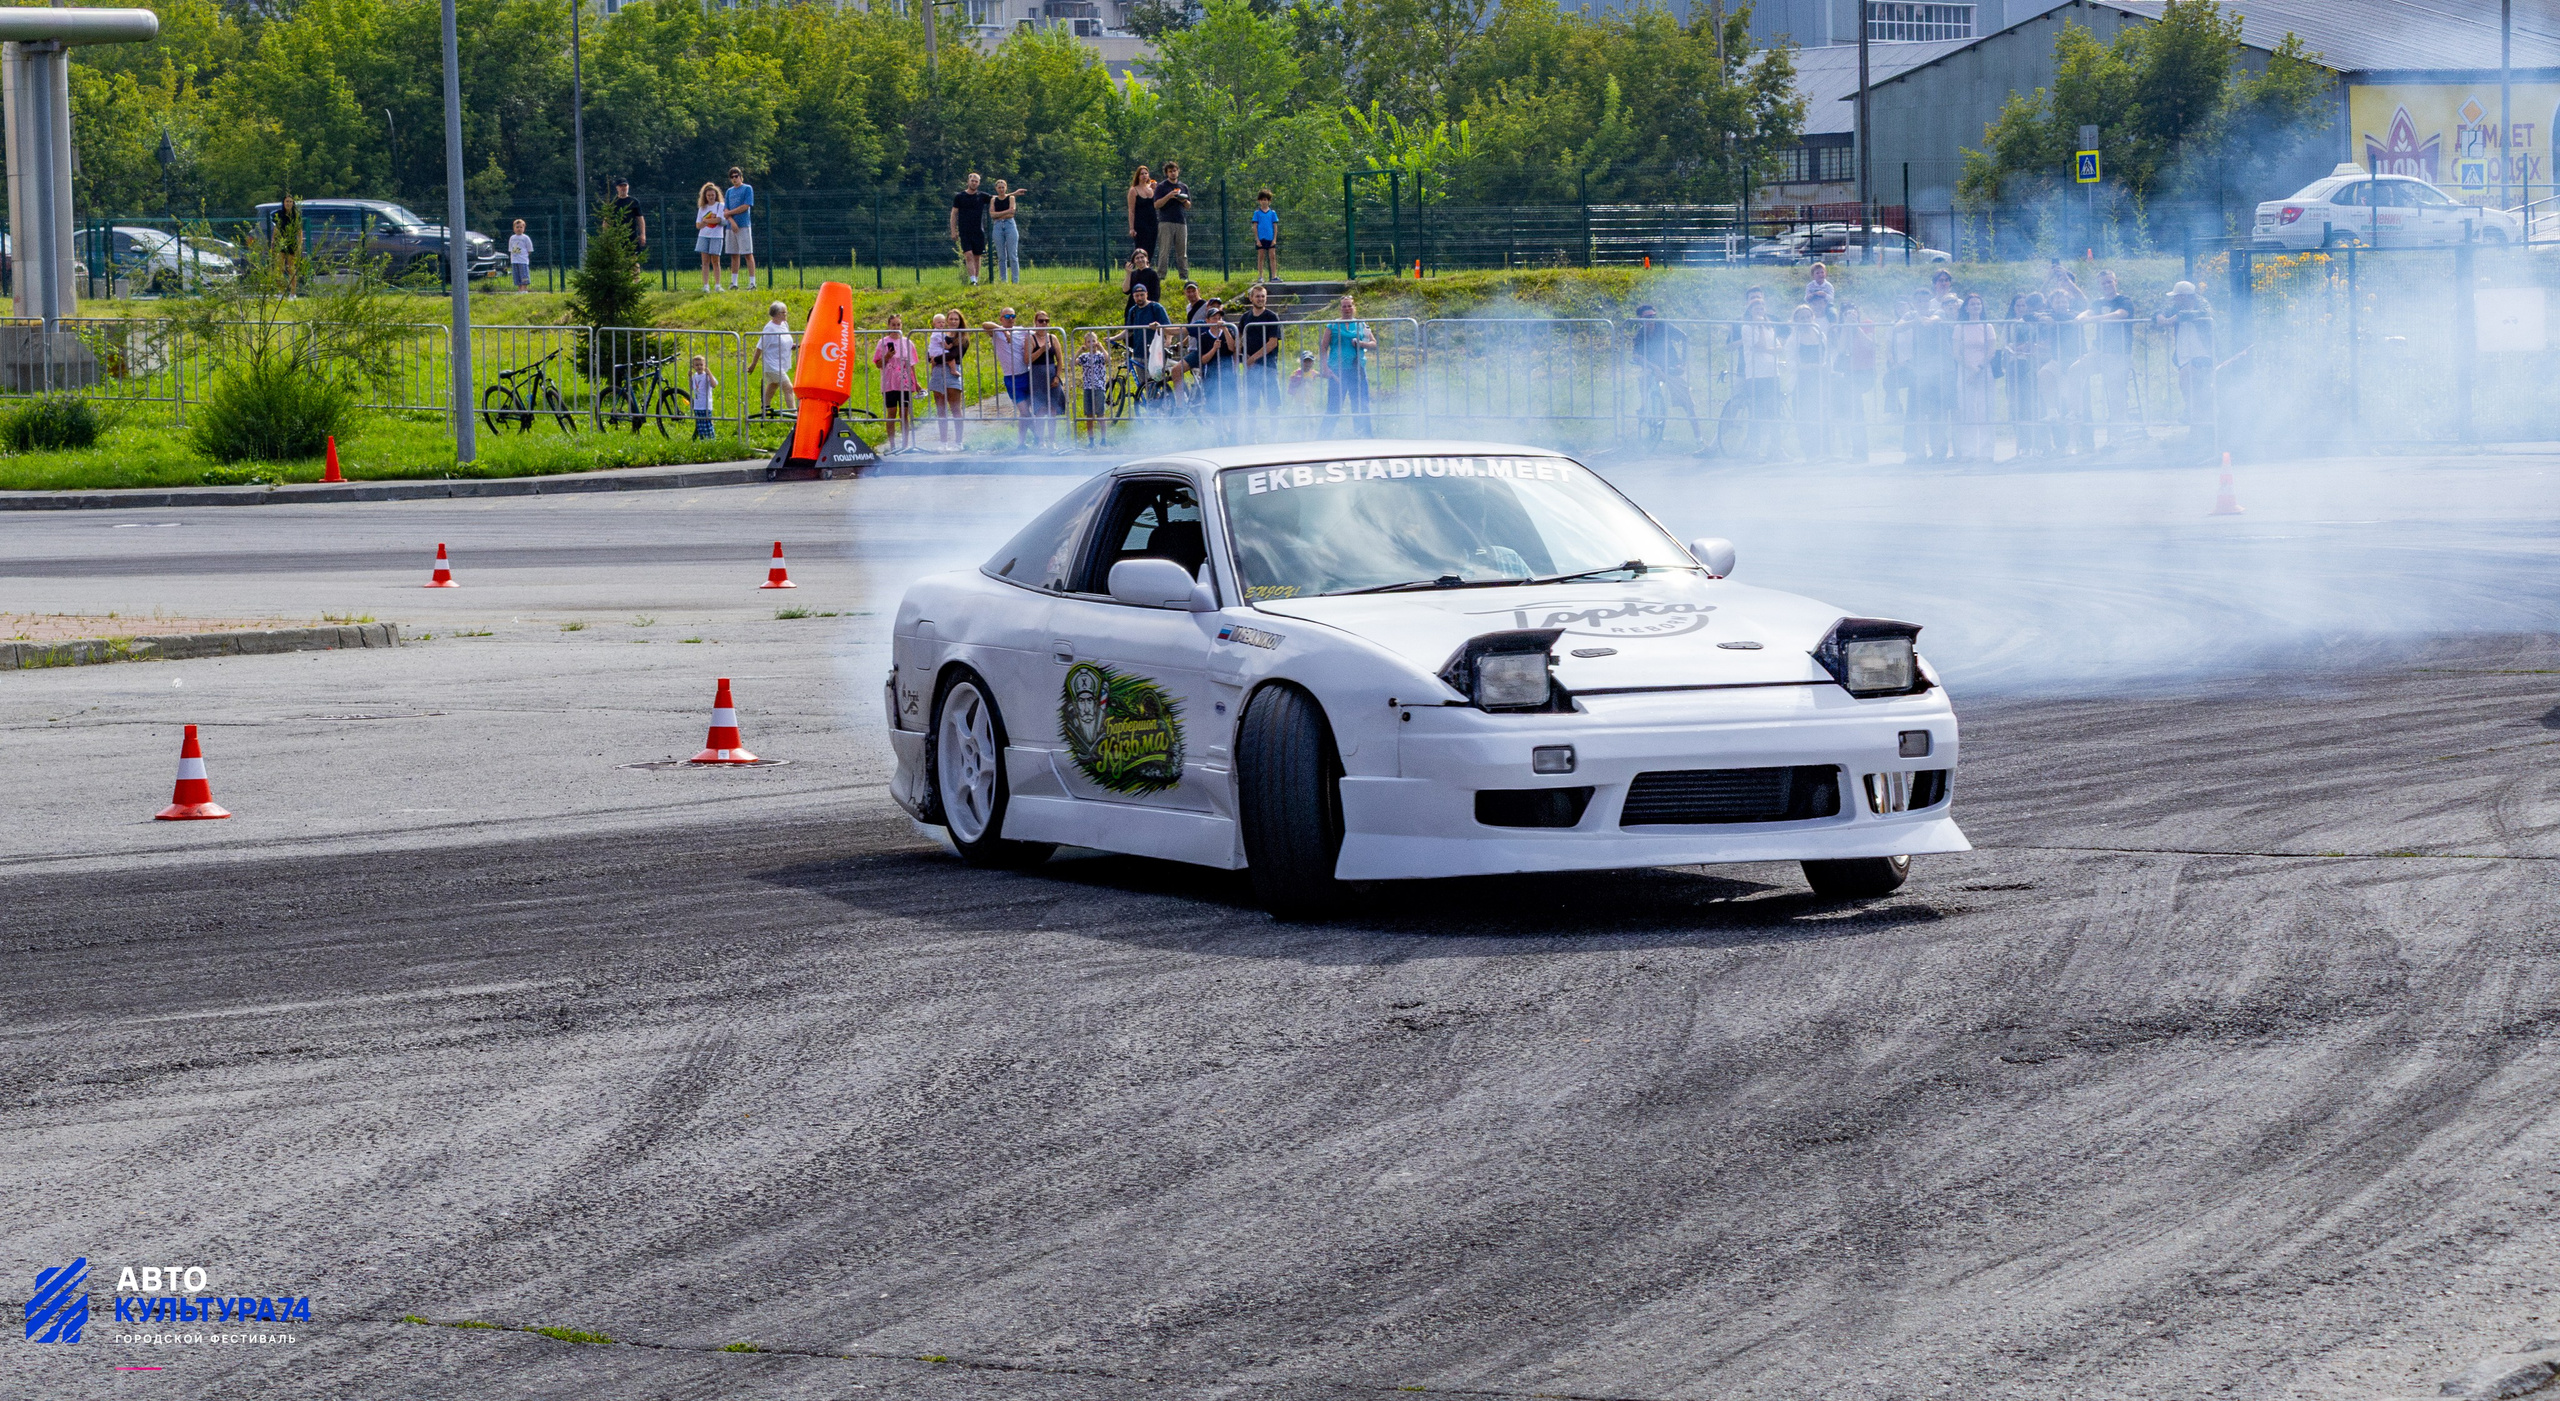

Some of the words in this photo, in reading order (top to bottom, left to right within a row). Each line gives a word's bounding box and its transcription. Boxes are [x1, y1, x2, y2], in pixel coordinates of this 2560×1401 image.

[2455, 123, 2535, 152] ДМЕТ
[836, 320, 850, 389] ПОШУМИМ!
[833, 452, 874, 463] ПОШУМИМ!
[1247, 457, 1574, 495] EKB.STADIUM.MEET
[1104, 716, 1158, 740] Барбершоп
[1096, 732, 1170, 779] Кузьма
